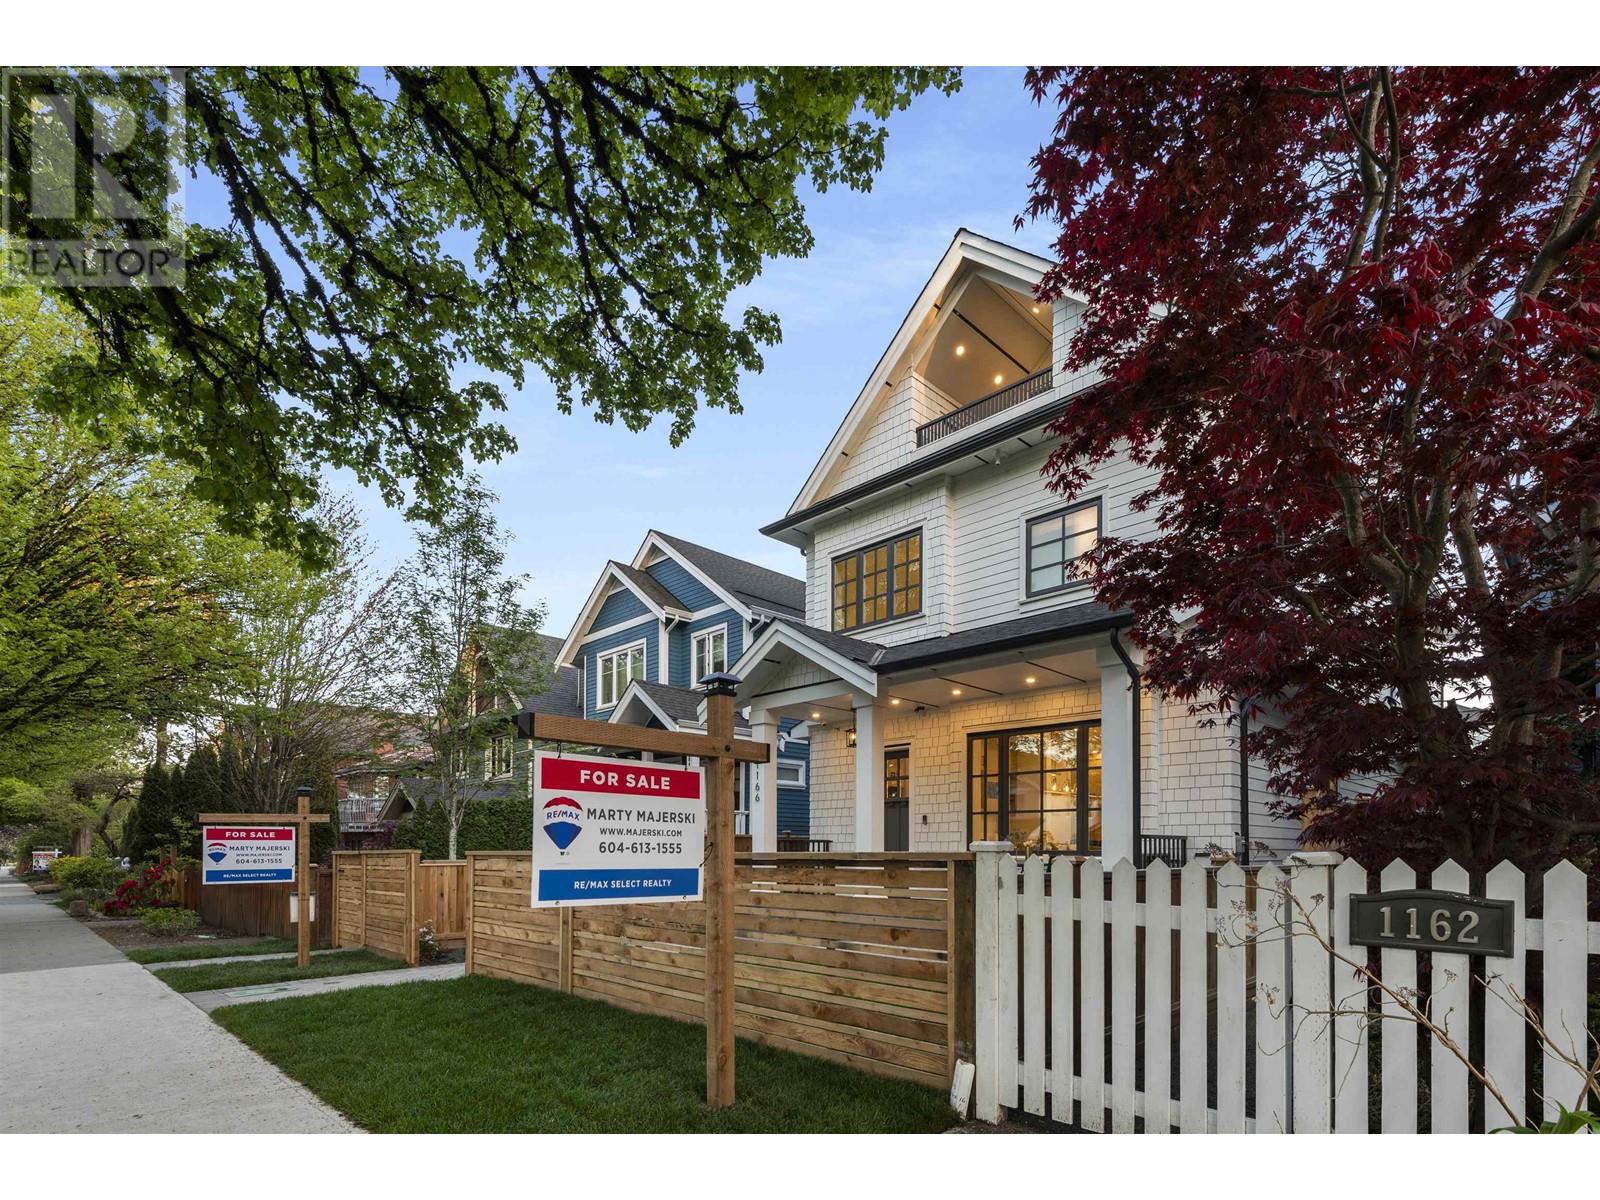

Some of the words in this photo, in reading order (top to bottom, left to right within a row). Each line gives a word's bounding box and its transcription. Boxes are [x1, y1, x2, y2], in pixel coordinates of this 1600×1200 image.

[580, 769, 619, 786] FOR
[625, 773, 671, 790] SALE
[546, 810, 580, 820] RE/MAX
[587, 808, 632, 821] MARTY
[637, 810, 695, 823] MAJERSKI
[600, 827, 682, 837] WWW.MAJERSKI.COM
[599, 842, 682, 854] 604-613-1555
[574, 880, 609, 890] RE/MAX
[611, 880, 641, 888] SELECT
[643, 879, 672, 887] REALTY
[1380, 906, 1479, 943] 1162
